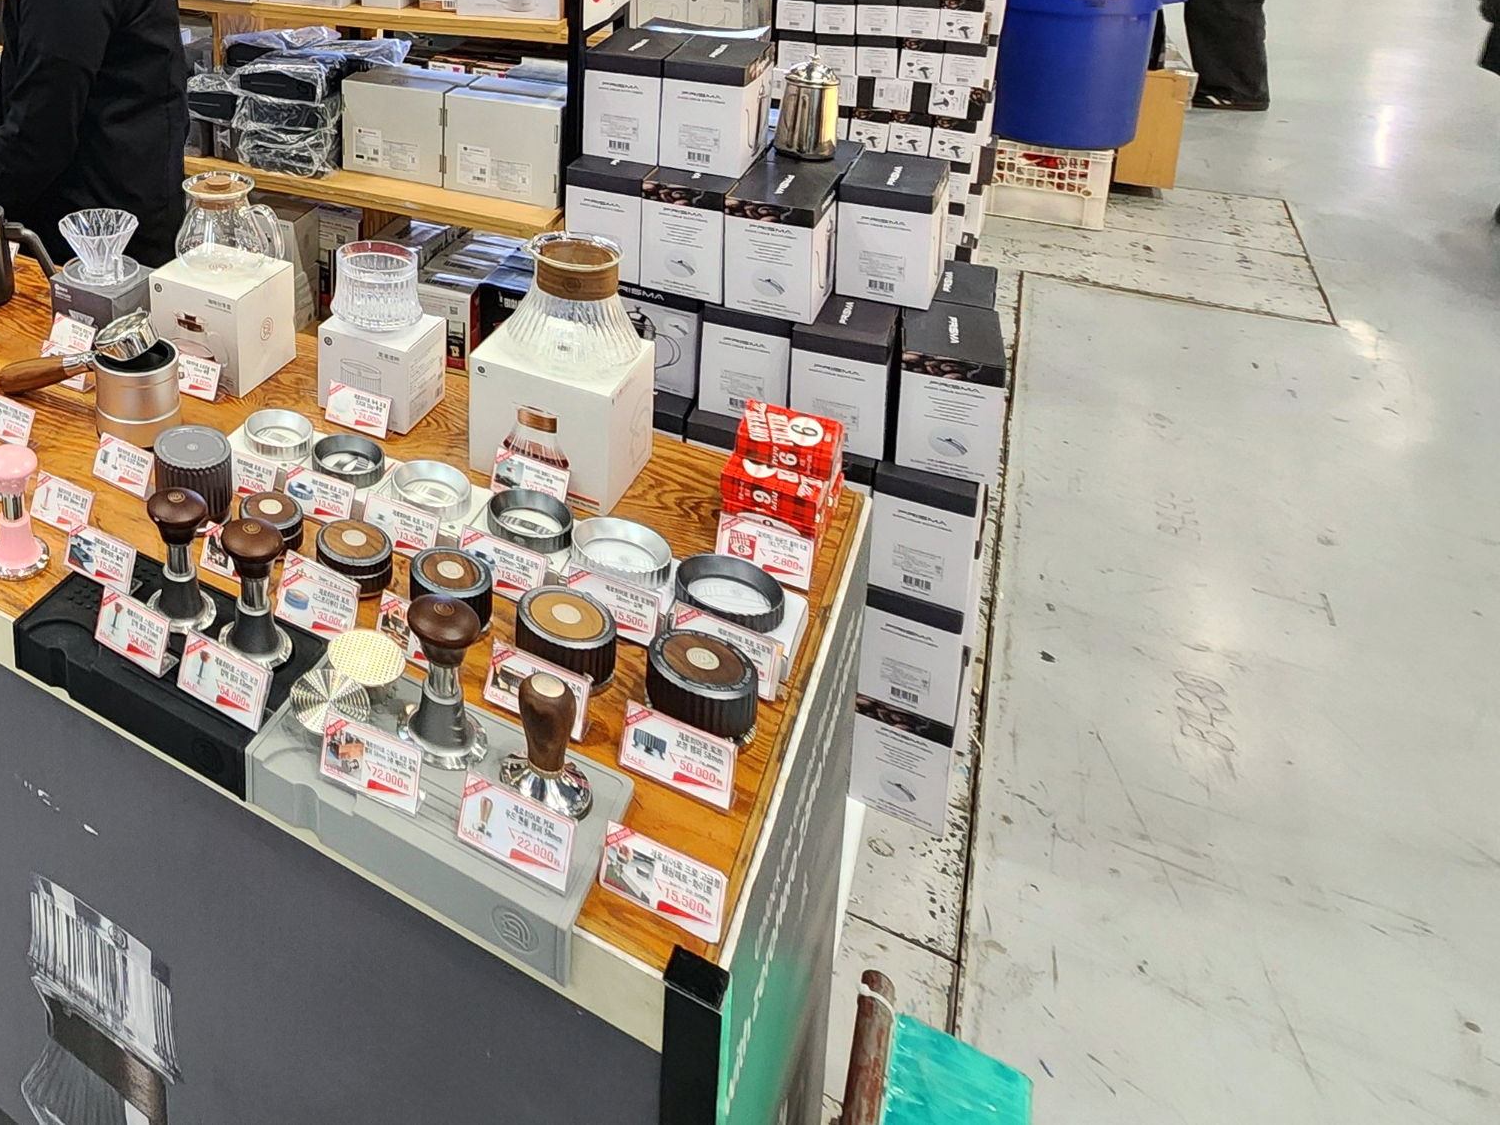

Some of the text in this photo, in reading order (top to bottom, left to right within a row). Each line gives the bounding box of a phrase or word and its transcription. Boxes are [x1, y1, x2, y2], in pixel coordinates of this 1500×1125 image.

[602, 81, 639, 90] PRISMA
[682, 90, 721, 100] PRISMA
[584, 198, 621, 209] PRISMA
[663, 206, 704, 218] PRISMA
[860, 215, 906, 226] PRISMA
[749, 223, 792, 235] PRISMA
[619, 286, 665, 301] RISMA
[723, 336, 766, 349] PRISMA
[813, 363, 860, 376] PRISMA
[928, 380, 980, 394] PRISMA
[898, 509, 947, 526] PRISMA
[885, 623, 934, 642] PRISMA
[544, 828, 563, 844] 58mm
